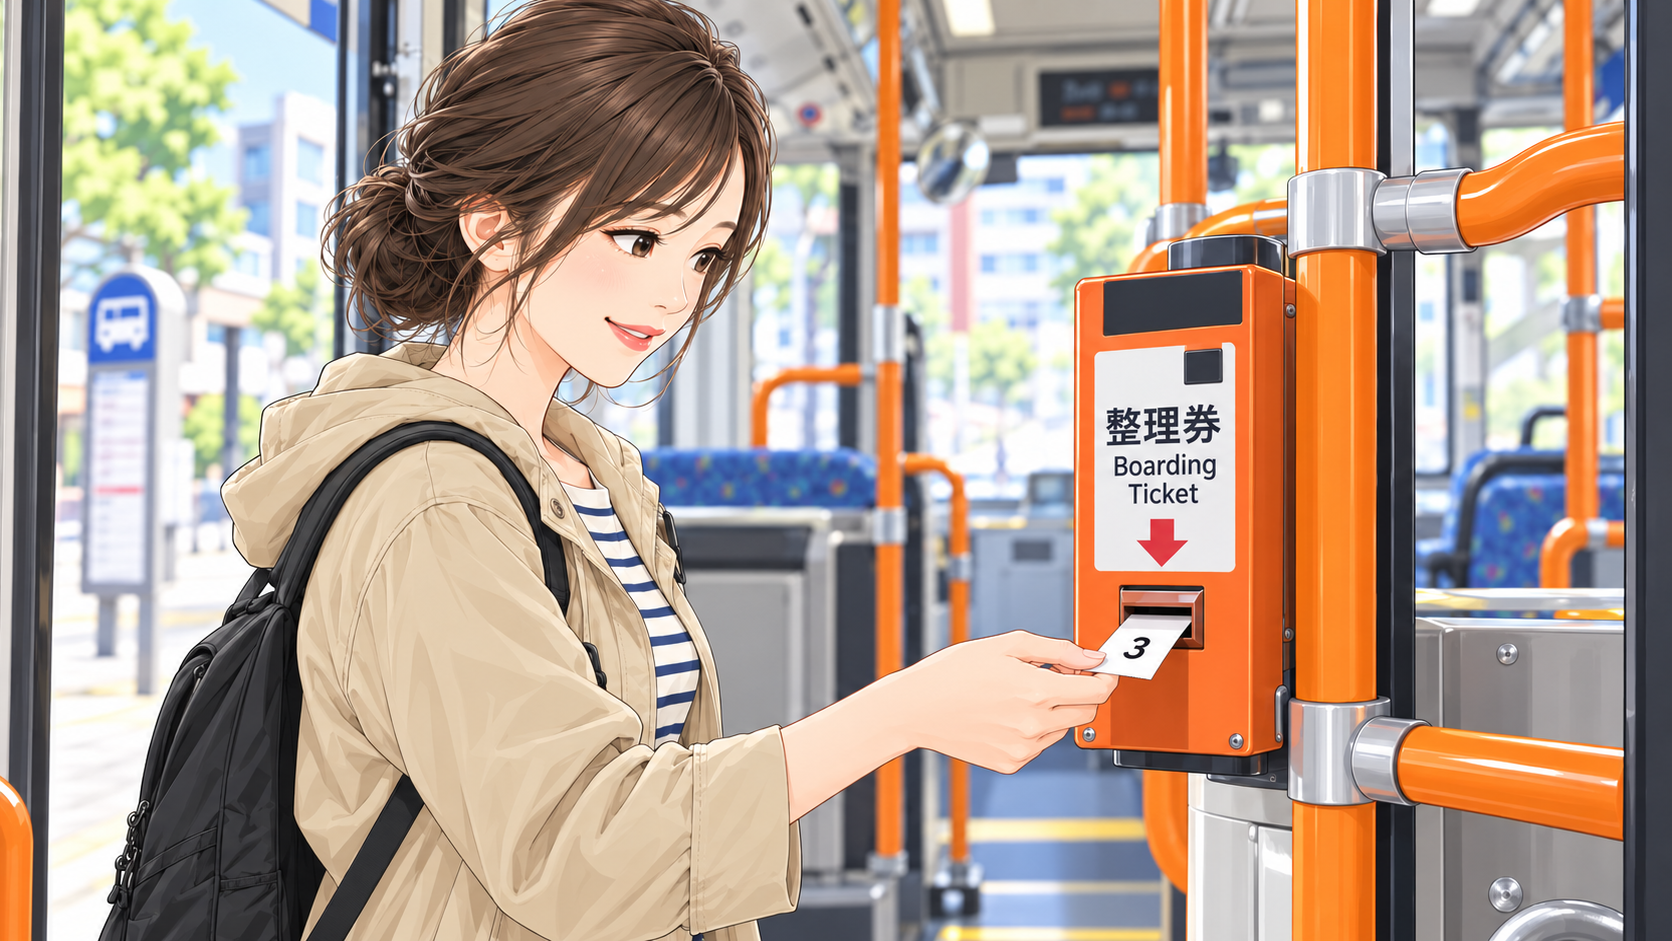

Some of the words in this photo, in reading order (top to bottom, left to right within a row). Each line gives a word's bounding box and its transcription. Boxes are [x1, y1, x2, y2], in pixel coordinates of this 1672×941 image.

[1106, 404, 1220, 446] 整理券
[1114, 453, 1217, 481] Boarding
[1128, 482, 1199, 505] Ticket
[1123, 636, 1151, 660] 3
